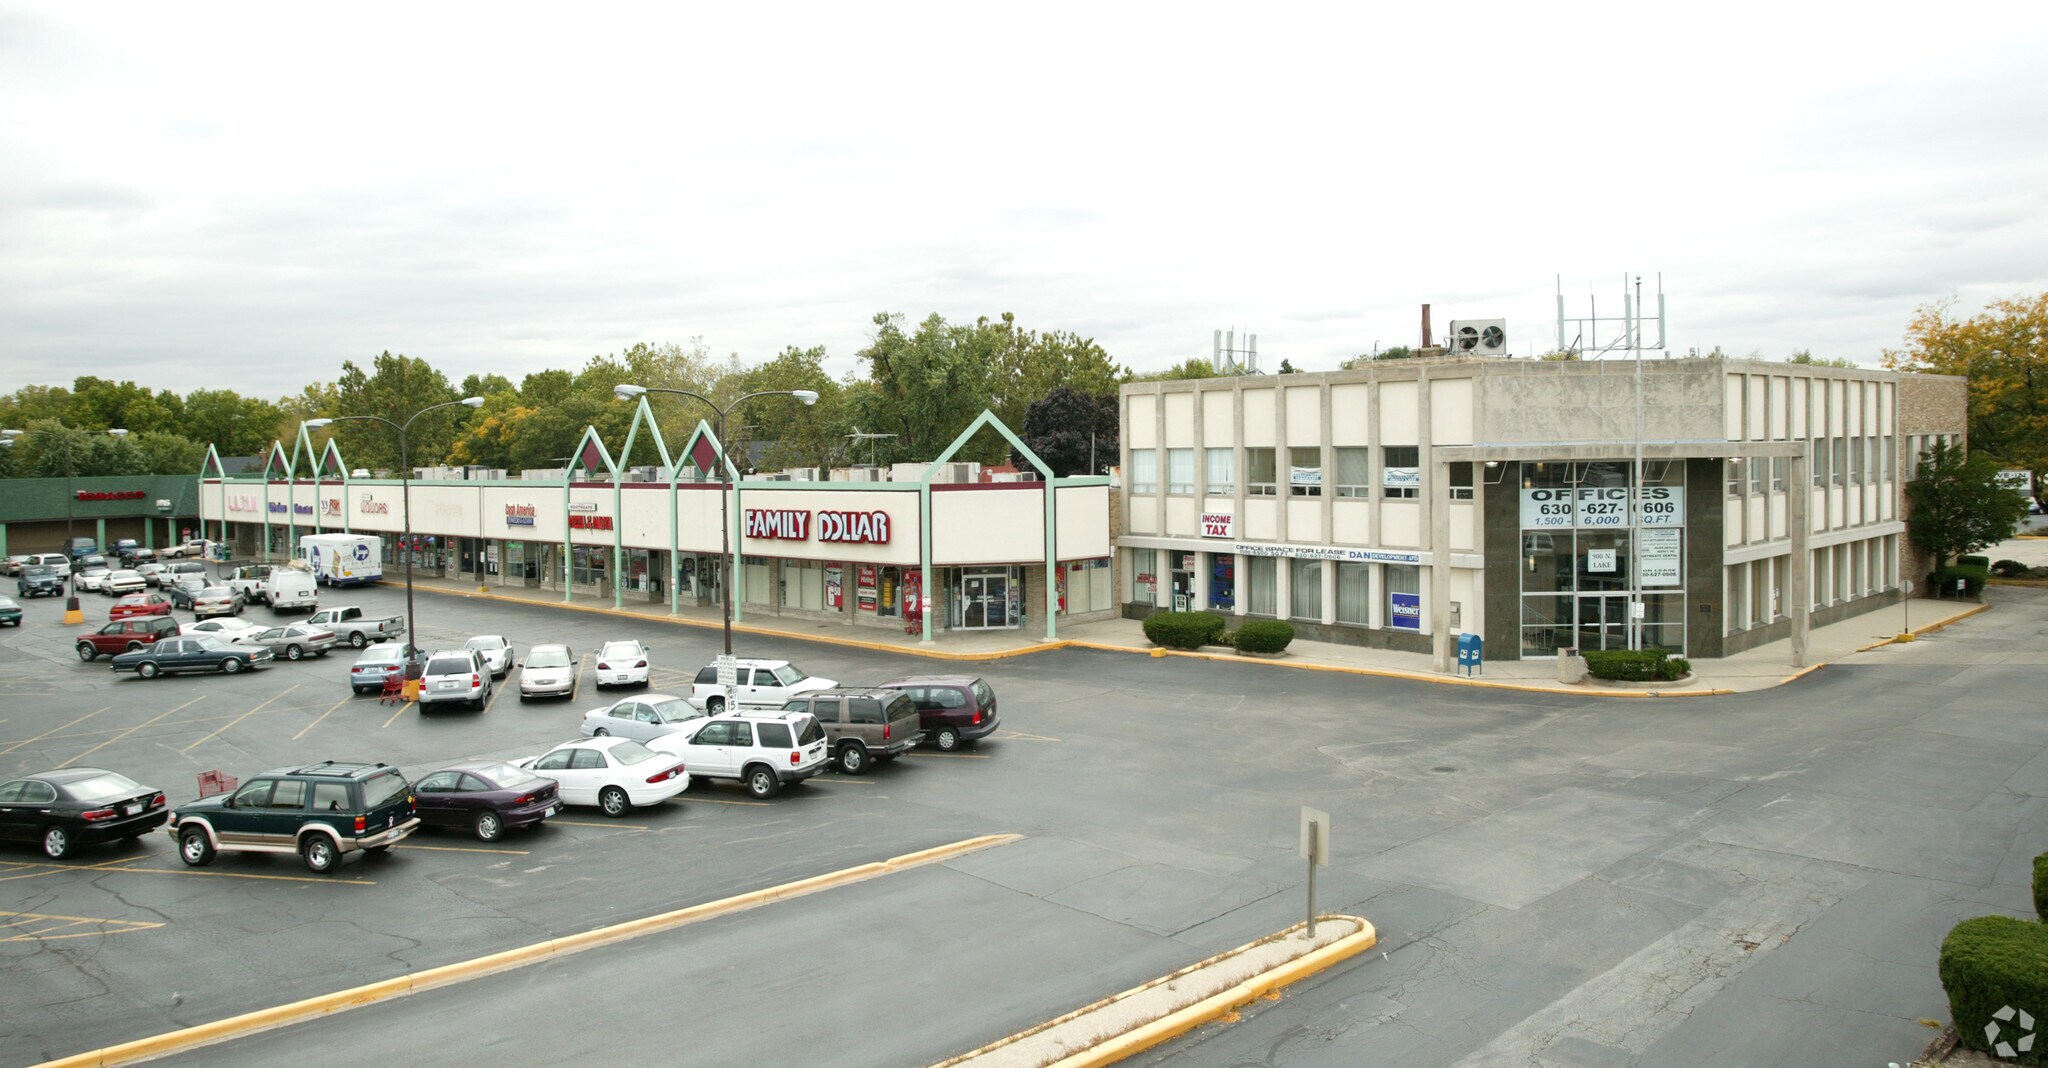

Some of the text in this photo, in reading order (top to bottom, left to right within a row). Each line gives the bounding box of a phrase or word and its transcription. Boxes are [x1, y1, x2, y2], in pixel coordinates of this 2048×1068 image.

[1531, 487, 1670, 501] OFFICES
[1202, 515, 1231, 524] INCOME
[1535, 517, 1564, 526] 1,500
[1584, 516, 1620, 526] 6,000
[1641, 515, 1672, 525] Q.FT.
[746, 510, 888, 543] FAMILY DOLLAR
[1206, 525, 1227, 536] TAX
[1349, 551, 1371, 559] DAN
[1373, 553, 1408, 561] DEVELOPMENT
